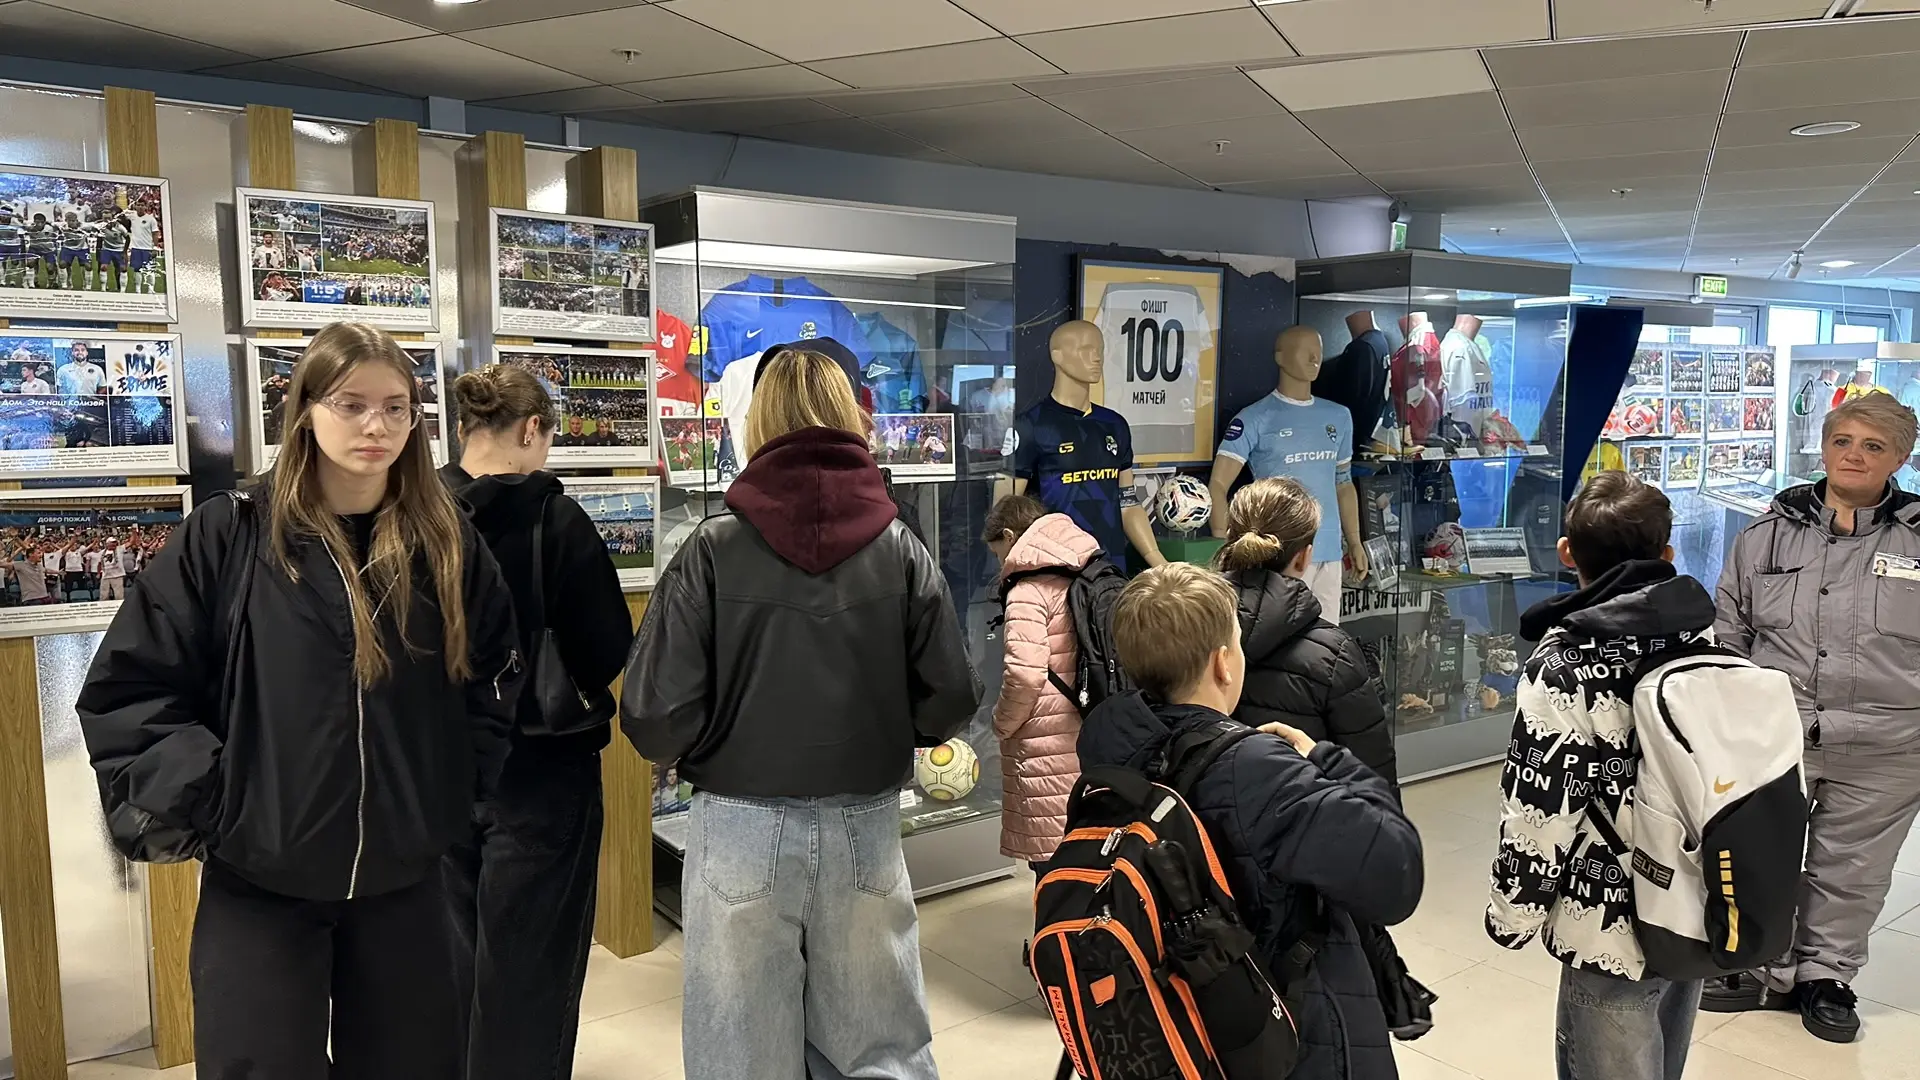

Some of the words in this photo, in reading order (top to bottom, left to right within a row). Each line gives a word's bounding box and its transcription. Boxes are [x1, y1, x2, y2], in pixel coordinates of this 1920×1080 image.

[1704, 280, 1724, 292] EXIT
[1141, 299, 1168, 313] ФИШТ
[1121, 317, 1184, 382] 100
[125, 353, 155, 376] МЫ
[27, 399, 45, 407] Это
[48, 399, 66, 407] наш
[68, 399, 105, 407] Колизей
[1132, 389, 1166, 404] МАТЧЕЙ
[1285, 450, 1337, 464] БЕТСИТИ
[1062, 469, 1118, 484] БЕТСИТИ
[1633, 856, 1671, 885] ELITE
